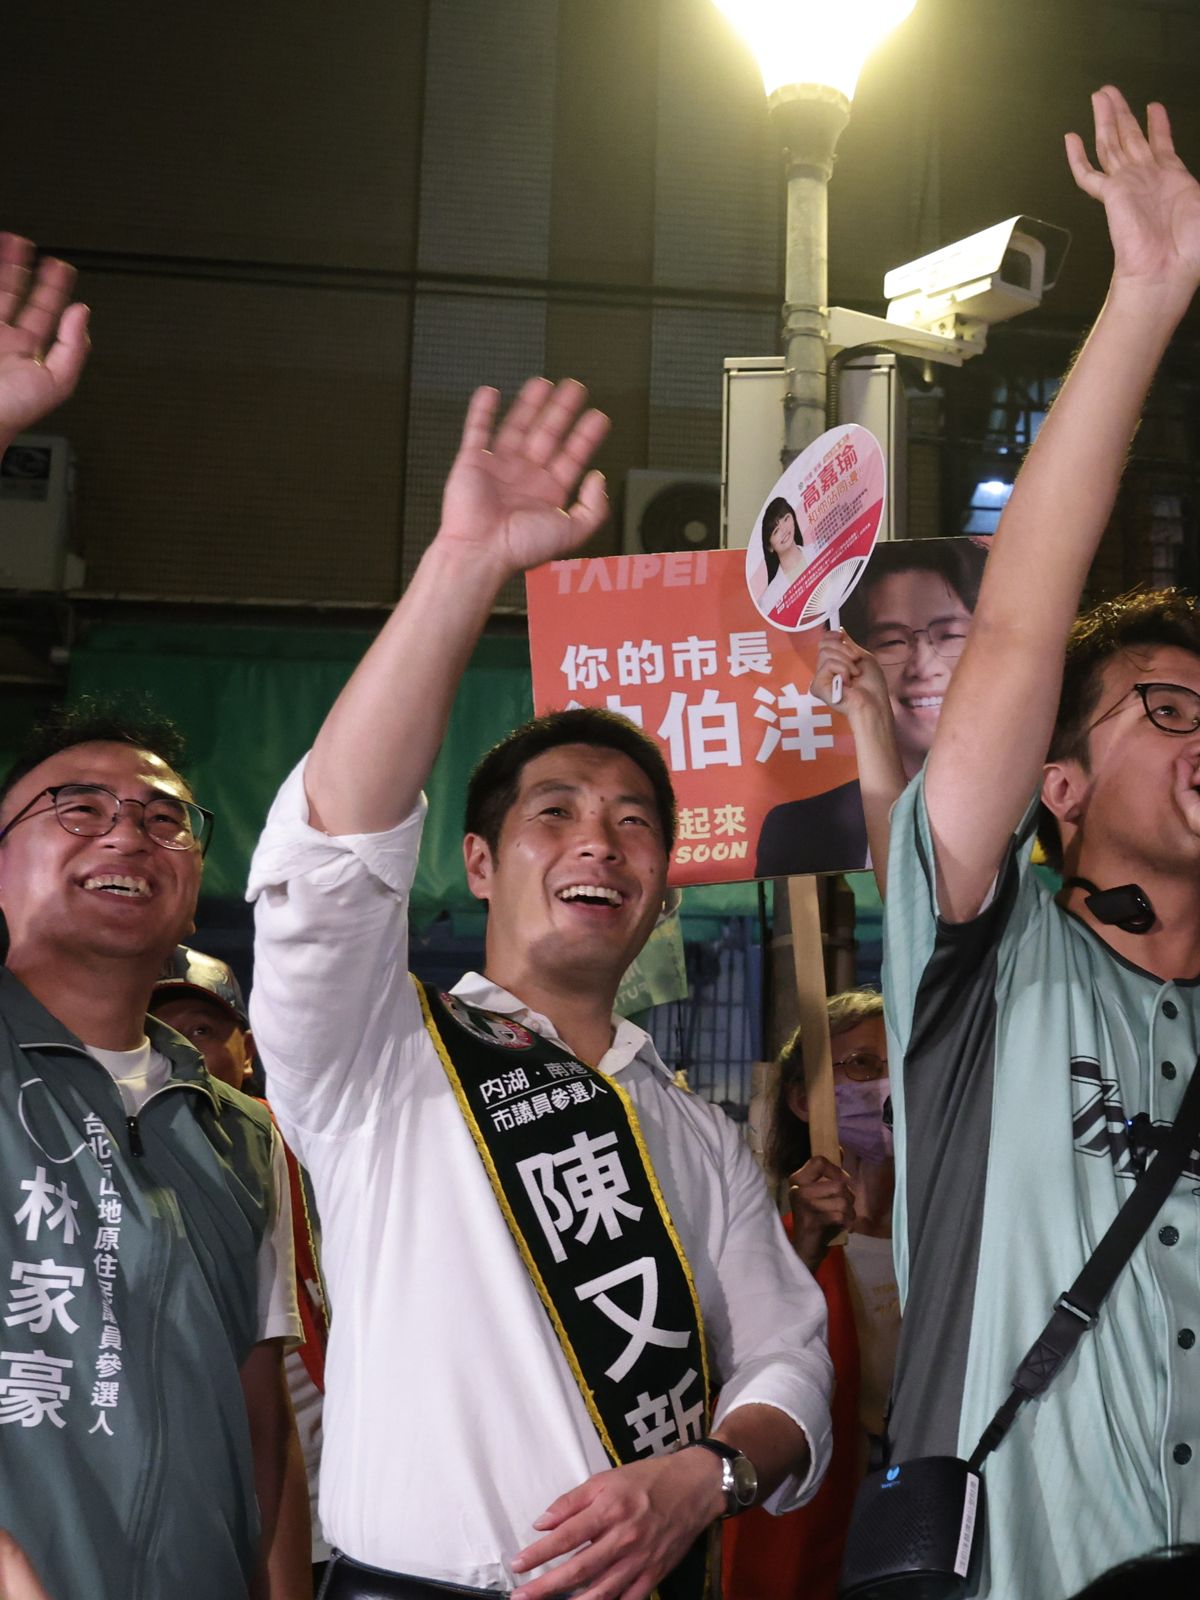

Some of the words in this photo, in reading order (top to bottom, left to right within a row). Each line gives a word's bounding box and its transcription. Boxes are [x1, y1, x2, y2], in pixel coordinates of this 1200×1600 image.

[800, 444, 858, 514] 高嘉瑜
[550, 551, 709, 595] TAIPEI
[560, 631, 773, 691] 你的市長
[565, 683, 835, 772] 伯洋
[677, 803, 748, 840] 起來
[675, 841, 749, 866] SOON
[491, 1079, 608, 1132] 市議員參選人
[0, 1166, 85, 1429] 林家豪
[516, 1130, 705, 1459] 陳又新
